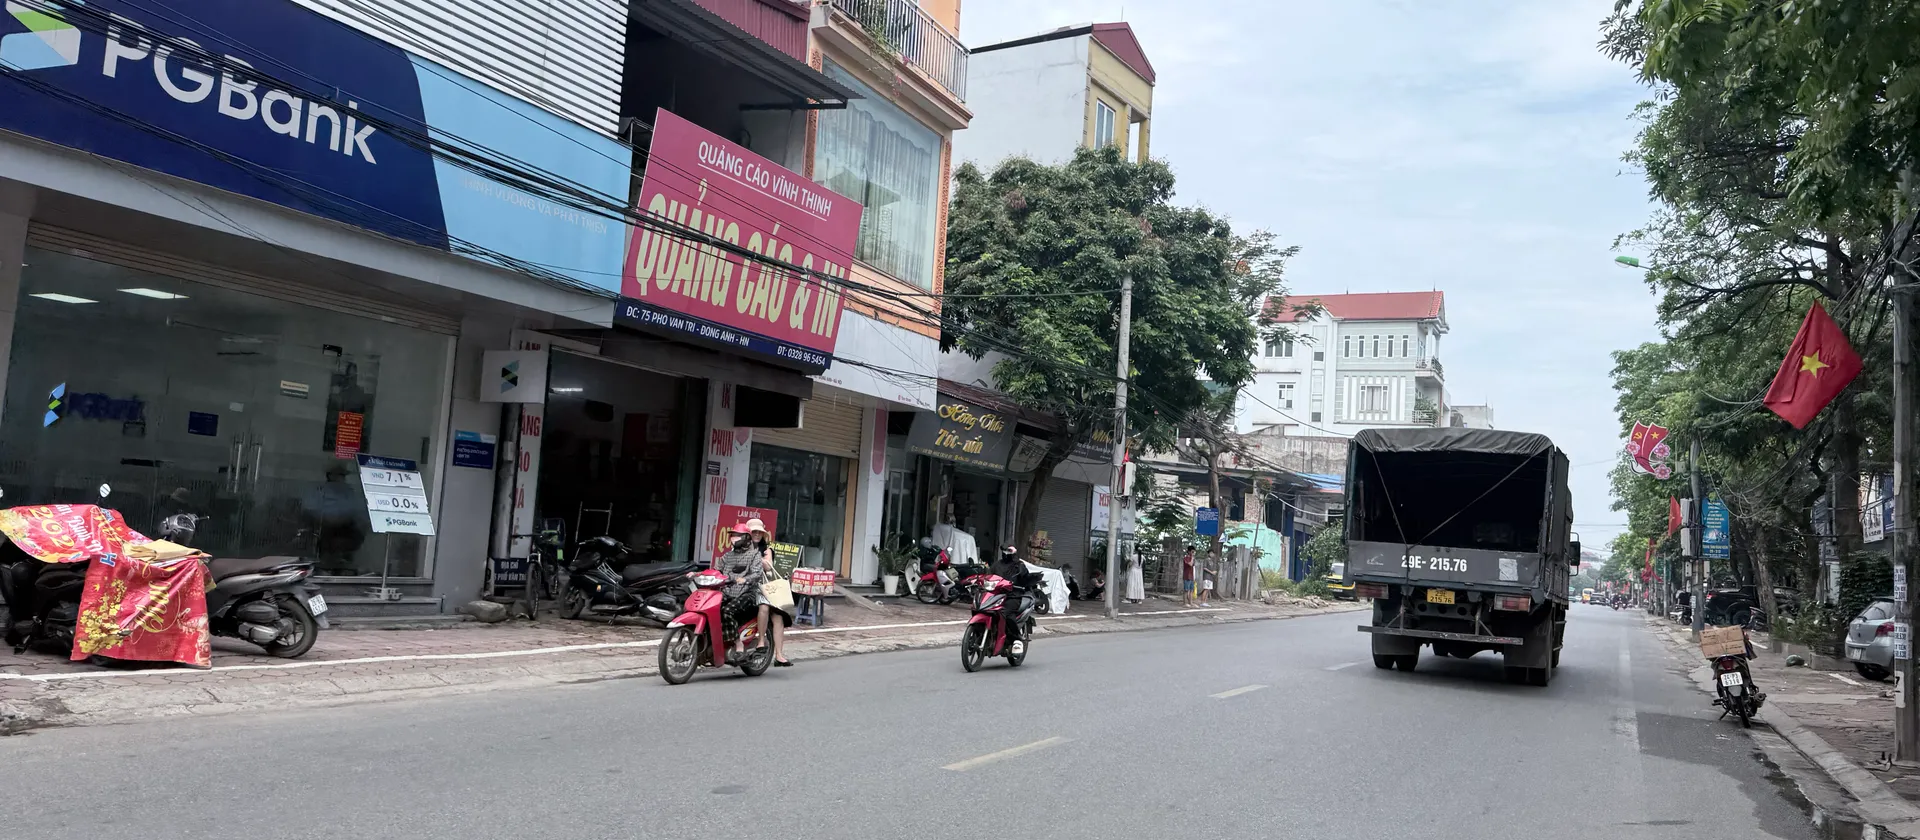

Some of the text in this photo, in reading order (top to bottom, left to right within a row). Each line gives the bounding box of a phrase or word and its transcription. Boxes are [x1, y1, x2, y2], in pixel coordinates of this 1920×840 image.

[102, 12, 377, 165] PGBank
[698, 141, 832, 217] QUẢNG CÁO VĨNH THỊNH
[634, 178, 847, 339] QUẢNG CÁO & IN
[626, 305, 639, 319] ĐC:
[640, 309, 651, 321] 75
[720, 330, 735, 343] ANH
[739, 334, 750, 347] HN
[777, 345, 826, 366] ĐT: 0328 96 5454
[711, 428, 734, 457] PHUN
[392, 518, 418, 527] PGBank
[1429, 556, 1468, 573] 215.76
